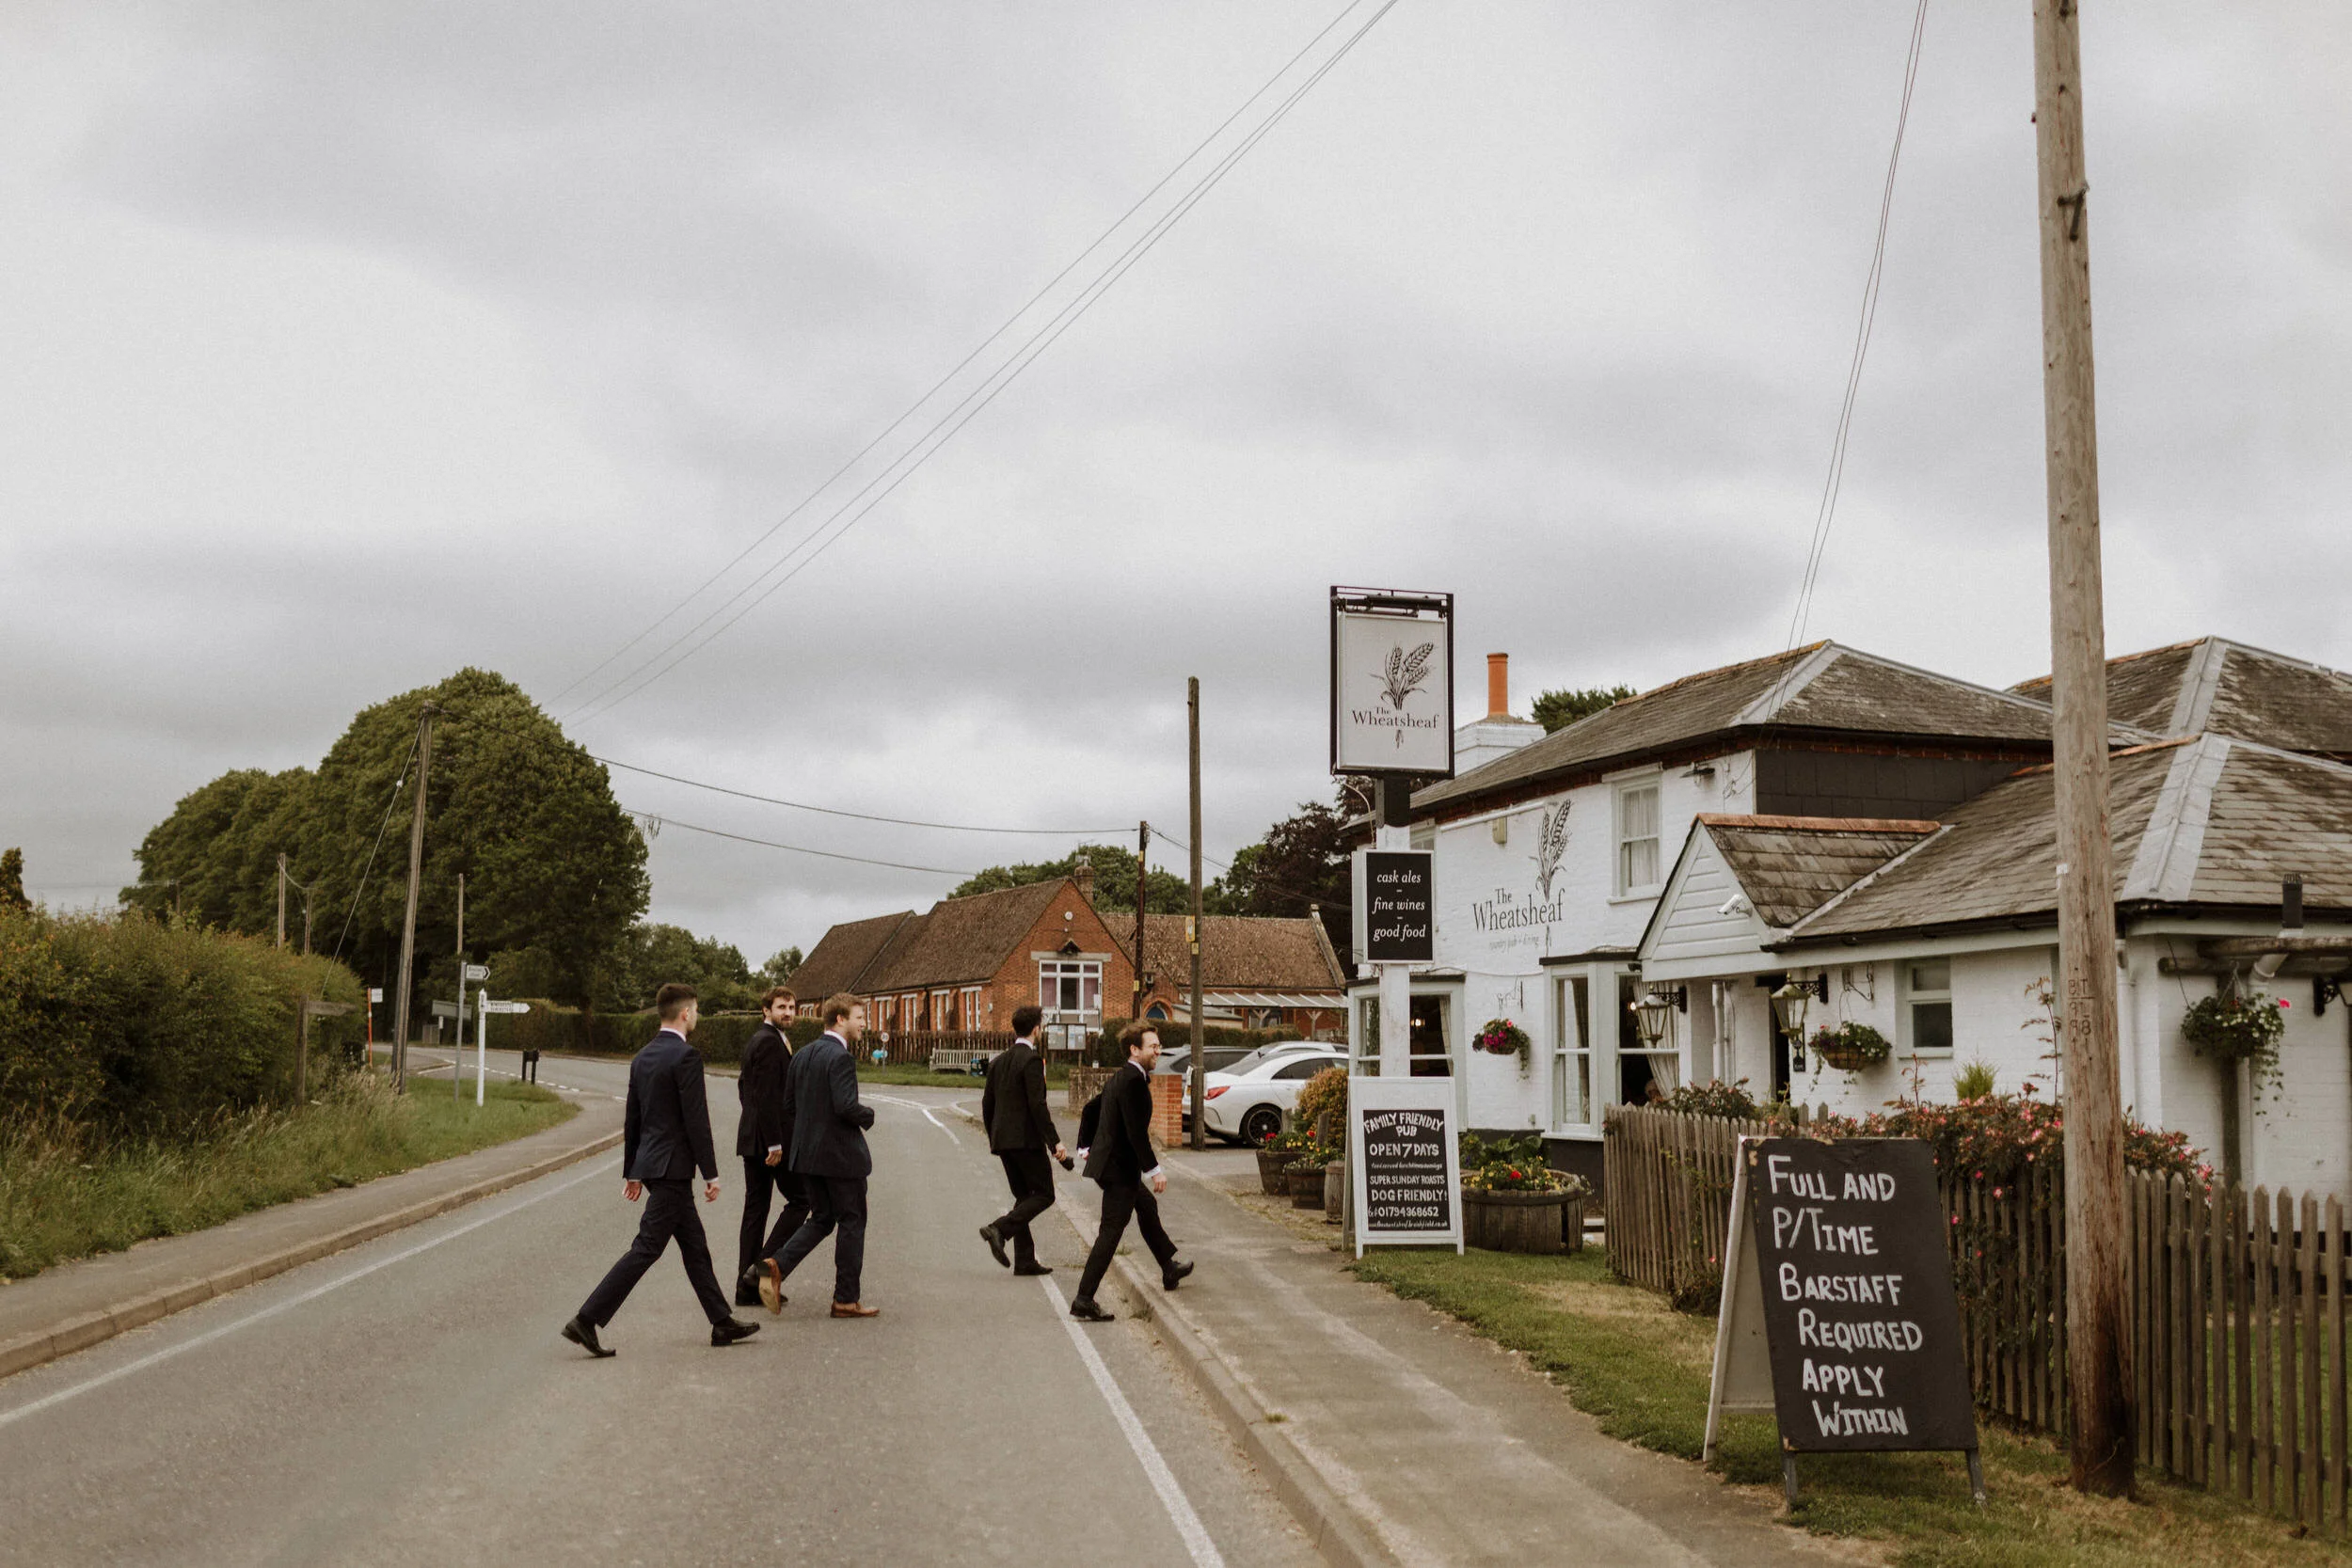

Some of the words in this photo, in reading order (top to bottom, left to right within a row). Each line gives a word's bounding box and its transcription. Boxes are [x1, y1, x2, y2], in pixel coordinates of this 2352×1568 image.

[1352, 710, 1439, 729] Wheatsheaf
[1376, 869, 1399, 883] cask
[1402, 869, 1422, 883] ales
[1372, 896, 1393, 914] fine
[1396, 898, 1425, 911] wines
[1495, 888, 1513, 904] The
[1472, 888, 1565, 931] Wheatsheaf
[1374, 925, 1400, 942] good
[1400, 925, 1426, 942] food
[1364, 1112, 1397, 1134] FAMILY
[1399, 1112, 1444, 1132] FRIENDLY
[1395, 1125, 1418, 1137] PUB
[1369, 1143, 1401, 1156] OPEN
[1402, 1143, 1413, 1158] 7
[1413, 1143, 1439, 1156] DAYS
[1370, 1175, 1391, 1185] SUPER
[1391, 1175, 1421, 1185] SUNDAY
[1421, 1175, 1446, 1185] ROASTS
[1768, 1154, 1836, 1200] FULL
[1843, 1172, 1896, 1202] AND
[1371, 1189, 1396, 1202] DOG
[1397, 1189, 1448, 1202] FRIENDLY!
[1377, 1206, 1439, 1218] 01794368652
[1778, 1262, 1903, 1306] BARSTAFF
[1798, 1307, 1923, 1354] REQUIRED
[1802, 1358, 1884, 1399] APPLY
[1812, 1399, 1909, 1437] WITHIN
